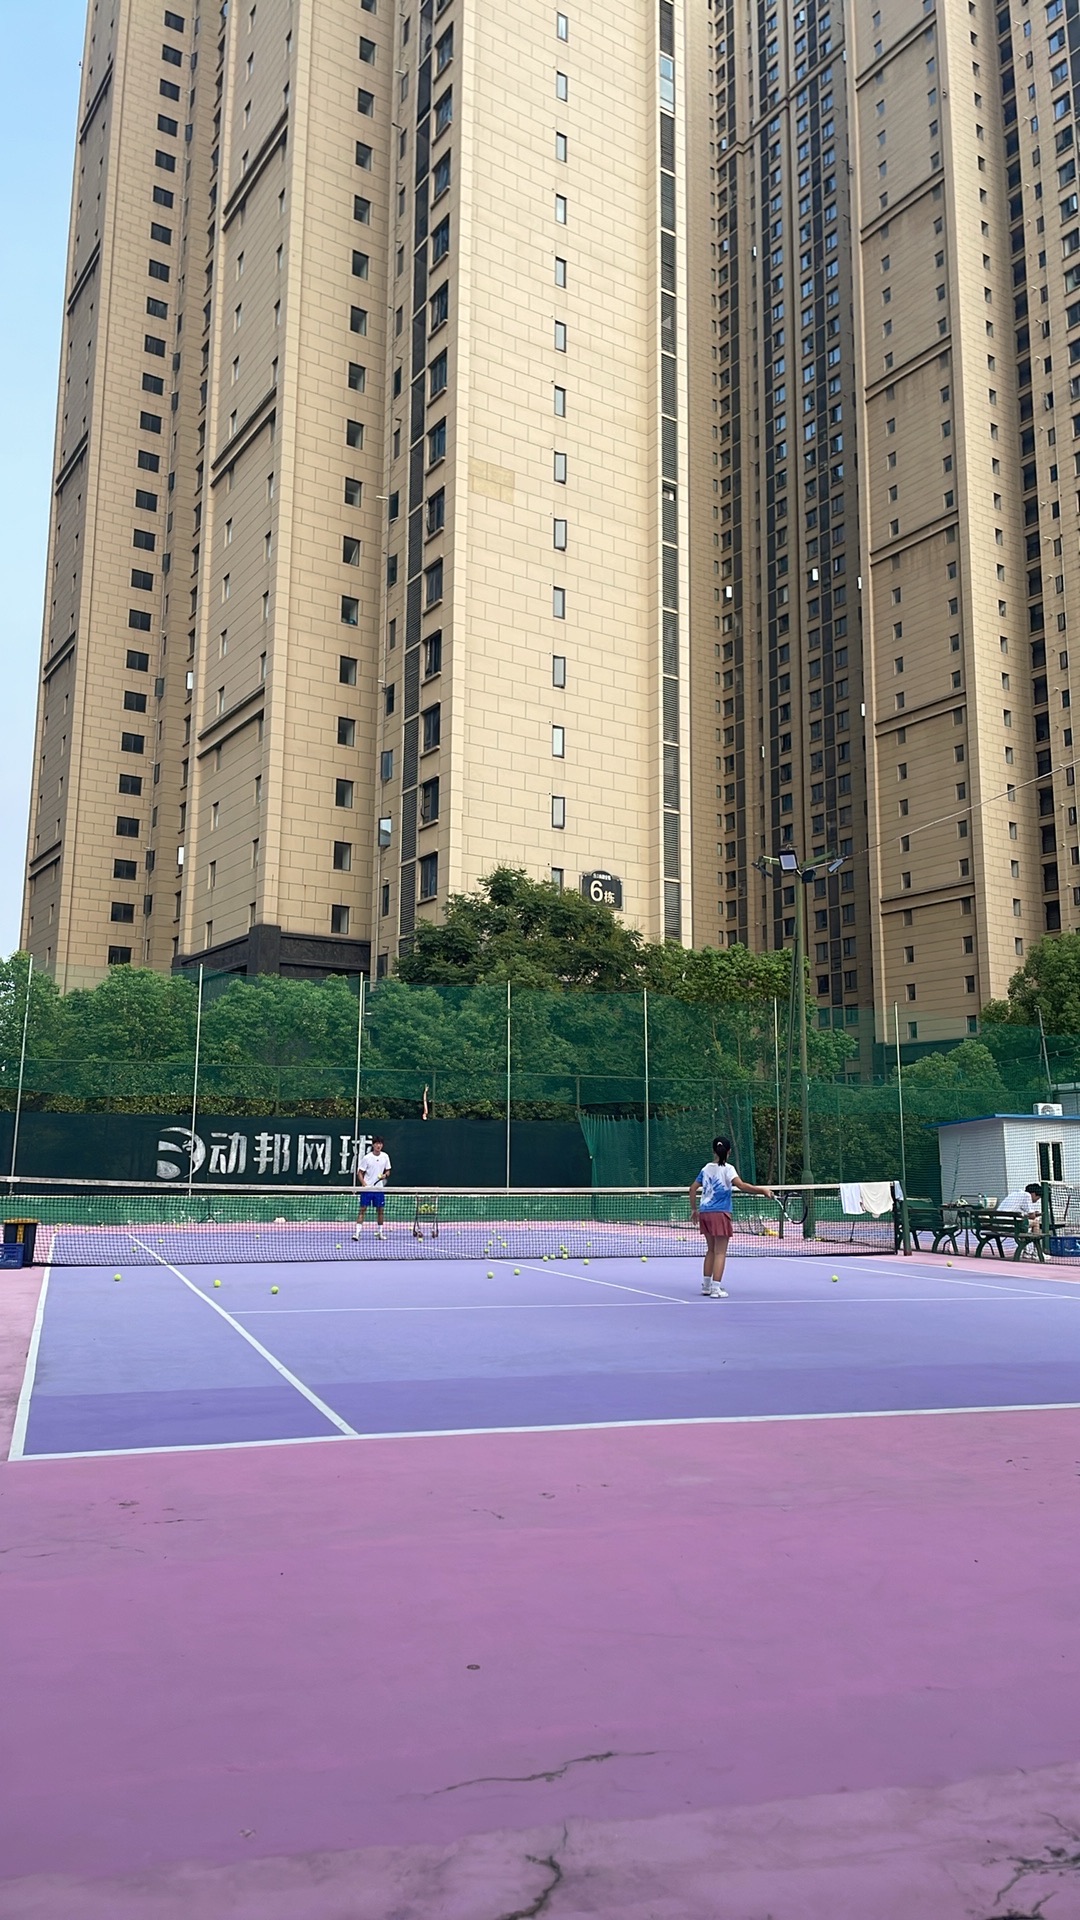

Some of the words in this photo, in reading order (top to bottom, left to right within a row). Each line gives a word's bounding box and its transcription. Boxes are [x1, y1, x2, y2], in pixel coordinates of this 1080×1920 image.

[590, 880, 616, 904] 6栋
[208, 1131, 373, 1175] 动邦网球
